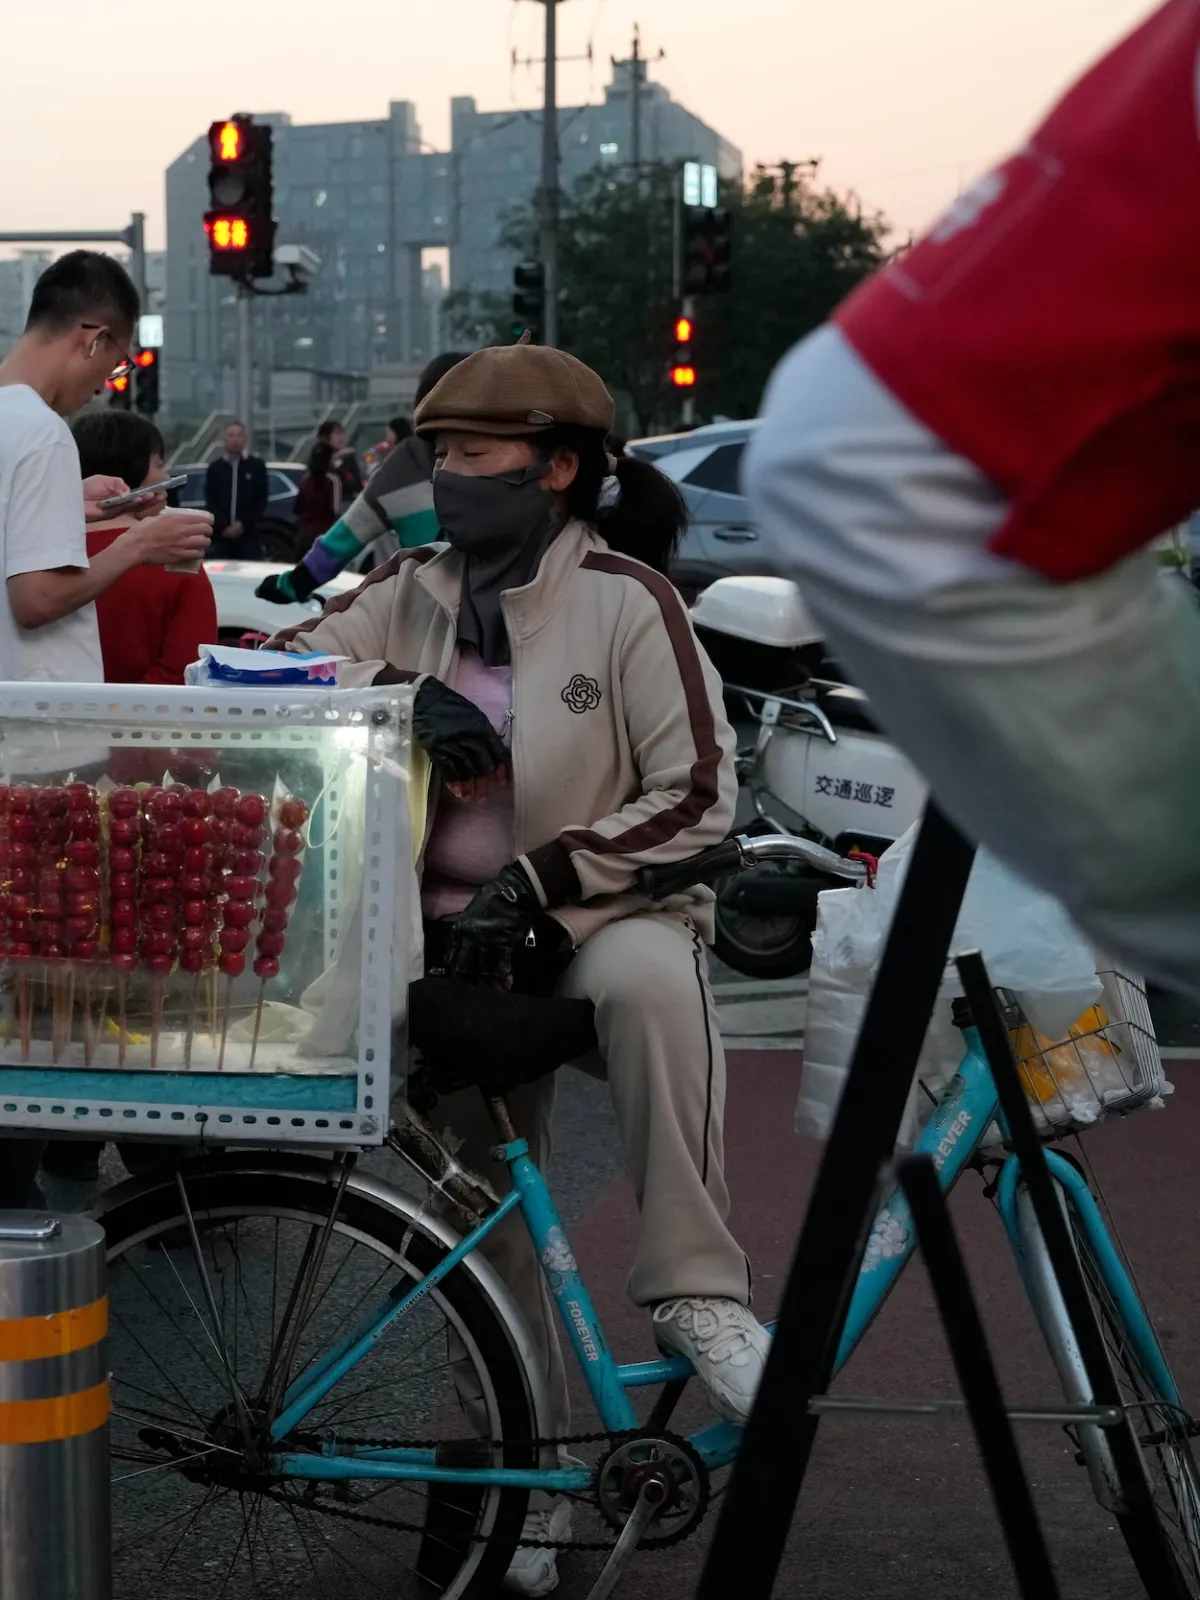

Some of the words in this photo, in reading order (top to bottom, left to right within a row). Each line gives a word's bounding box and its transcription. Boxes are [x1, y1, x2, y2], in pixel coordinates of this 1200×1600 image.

[814, 775, 895, 808] 交通巡逻
[932, 1110, 972, 1171] REVER
[566, 1300, 599, 1362] FOREVER
